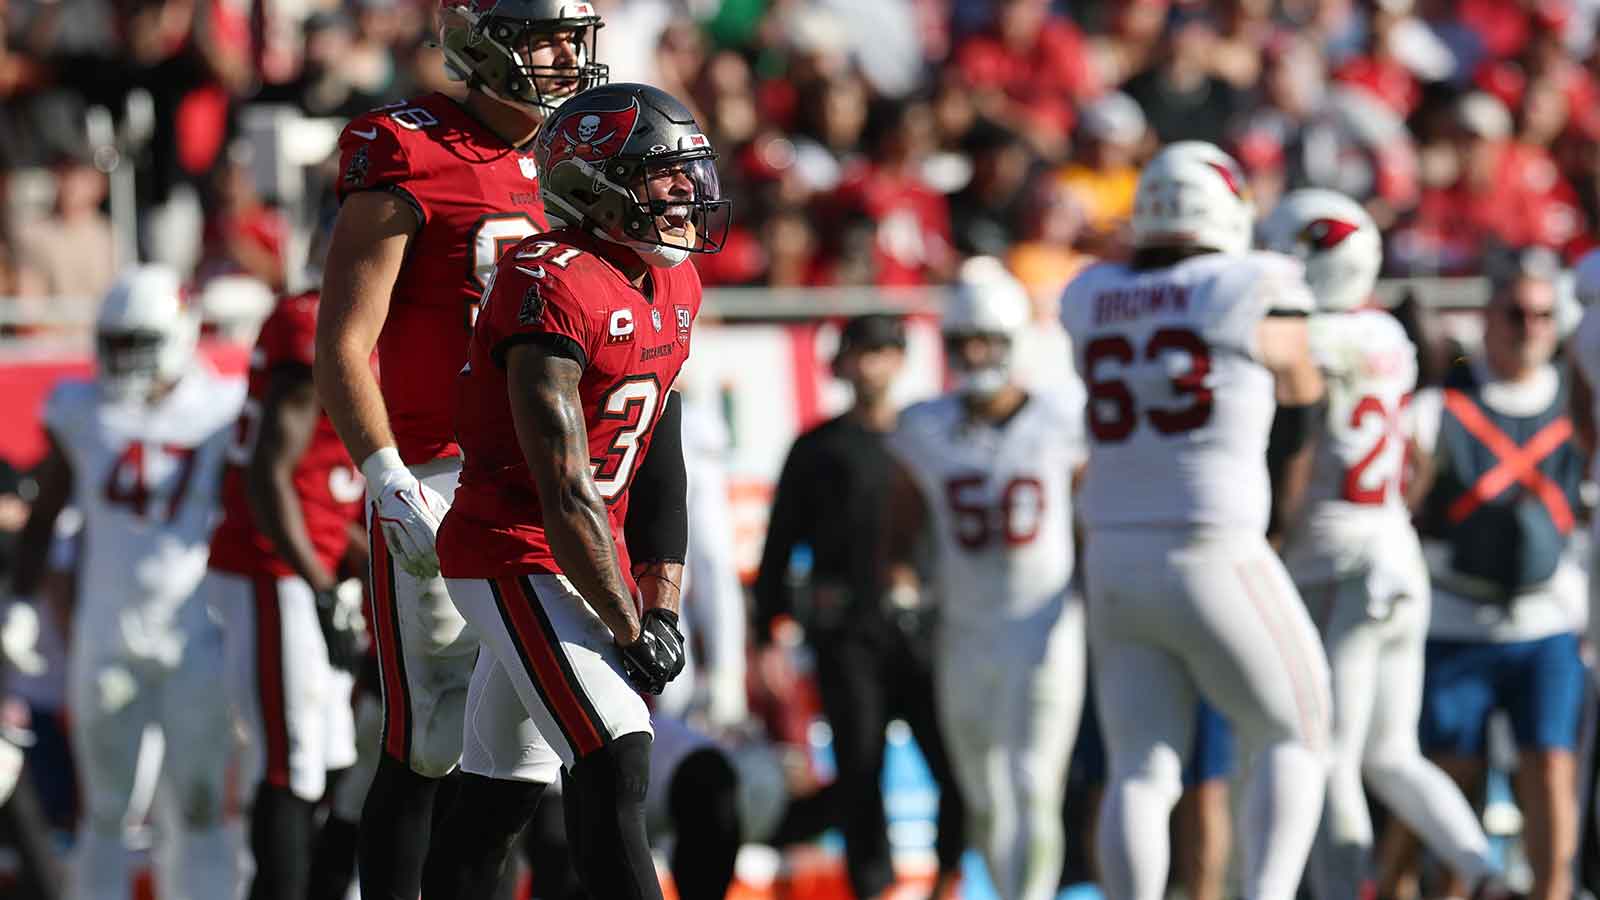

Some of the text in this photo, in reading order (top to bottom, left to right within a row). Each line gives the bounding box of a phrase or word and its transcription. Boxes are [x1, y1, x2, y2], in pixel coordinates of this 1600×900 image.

[513, 239, 582, 270] 31
[609, 309, 634, 337] C
[677, 309, 690, 328] 50
[1093, 283, 1191, 324] BROWN
[1084, 327, 1214, 443] 63
[104, 439, 196, 521] 47
[944, 474, 1046, 551] 50
